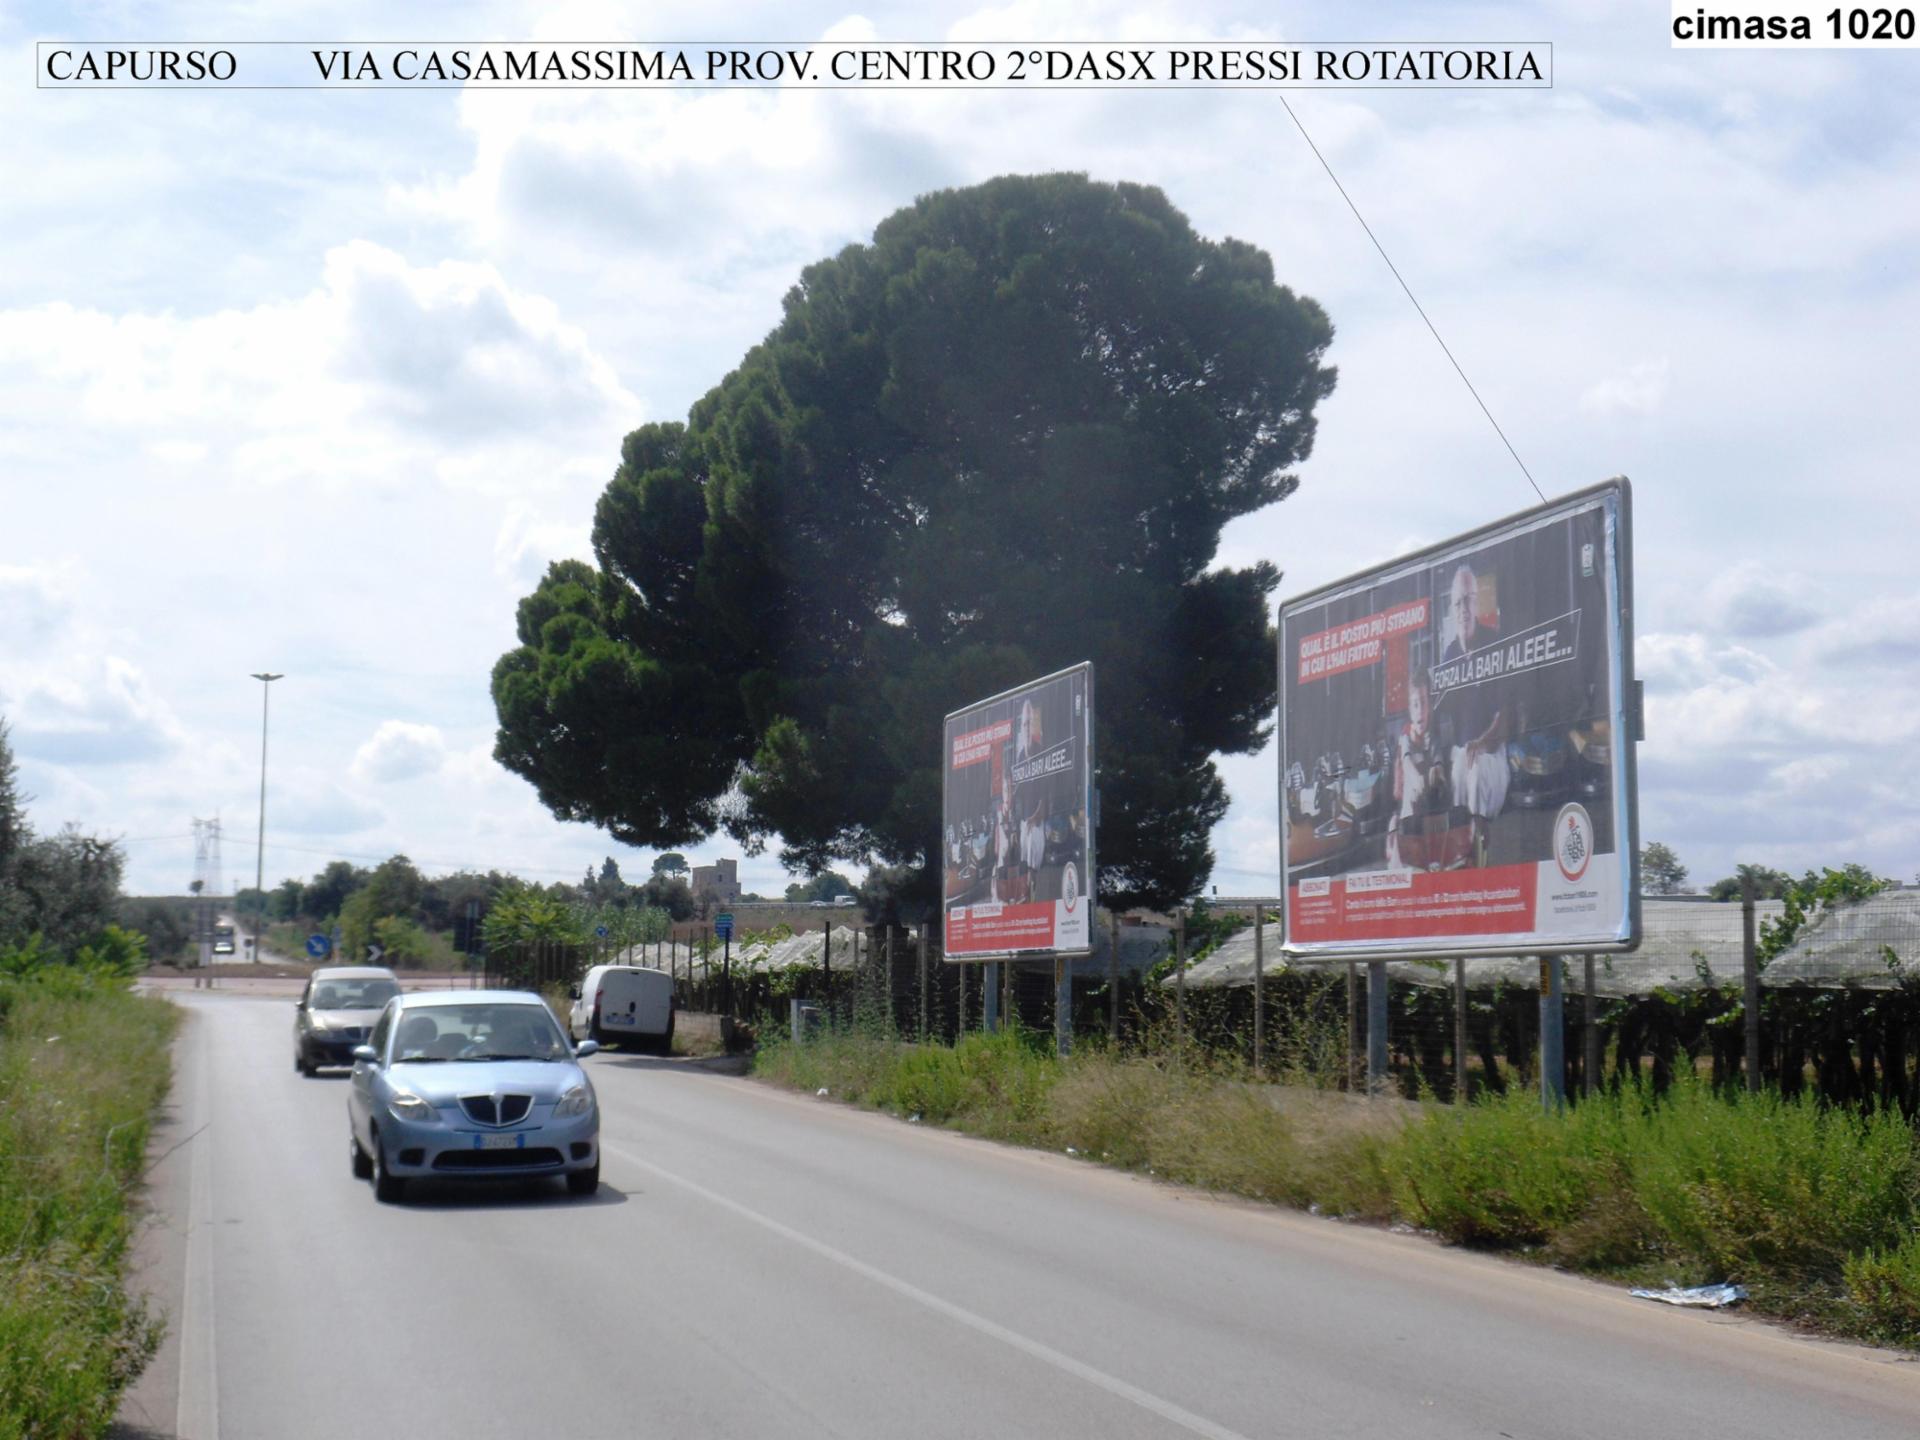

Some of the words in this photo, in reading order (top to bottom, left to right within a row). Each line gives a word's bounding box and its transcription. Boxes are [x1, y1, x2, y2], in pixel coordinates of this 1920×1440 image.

[1301, 638, 1322, 658] QUAL
[1340, 623, 1369, 646] POSTO
[1370, 614, 1386, 637] PIÙ
[1387, 605, 1425, 632] STRANO
[1434, 666, 1459, 688] FORZA
[1461, 661, 1473, 682] LA
[1476, 649, 1504, 679] BARI
